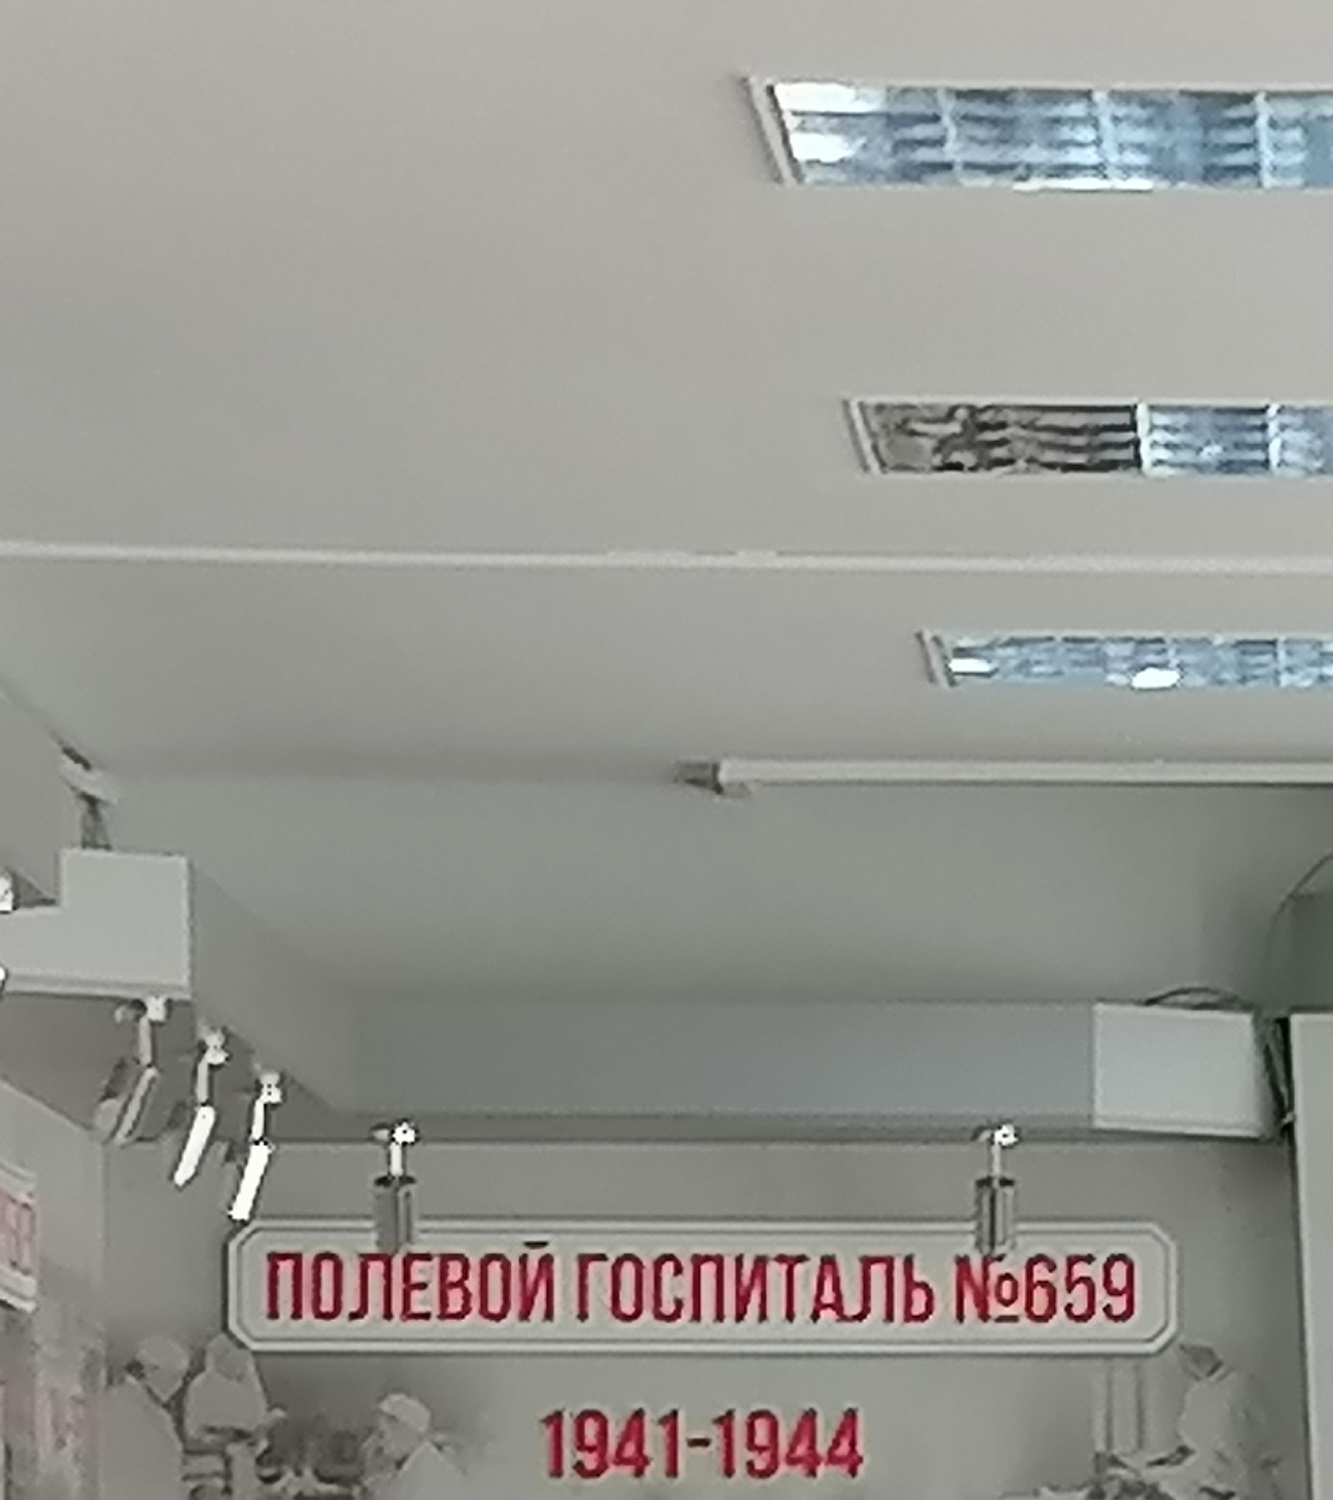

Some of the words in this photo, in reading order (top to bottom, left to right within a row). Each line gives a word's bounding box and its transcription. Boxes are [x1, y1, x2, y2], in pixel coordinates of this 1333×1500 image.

[265, 1241, 556, 1322] ПОЛЕВОЙ
[576, 1254, 935, 1325] ГОСПИТАЛЬ
[953, 1255, 1138, 1324] №659
[541, 1408, 865, 1480] 1941-1944
